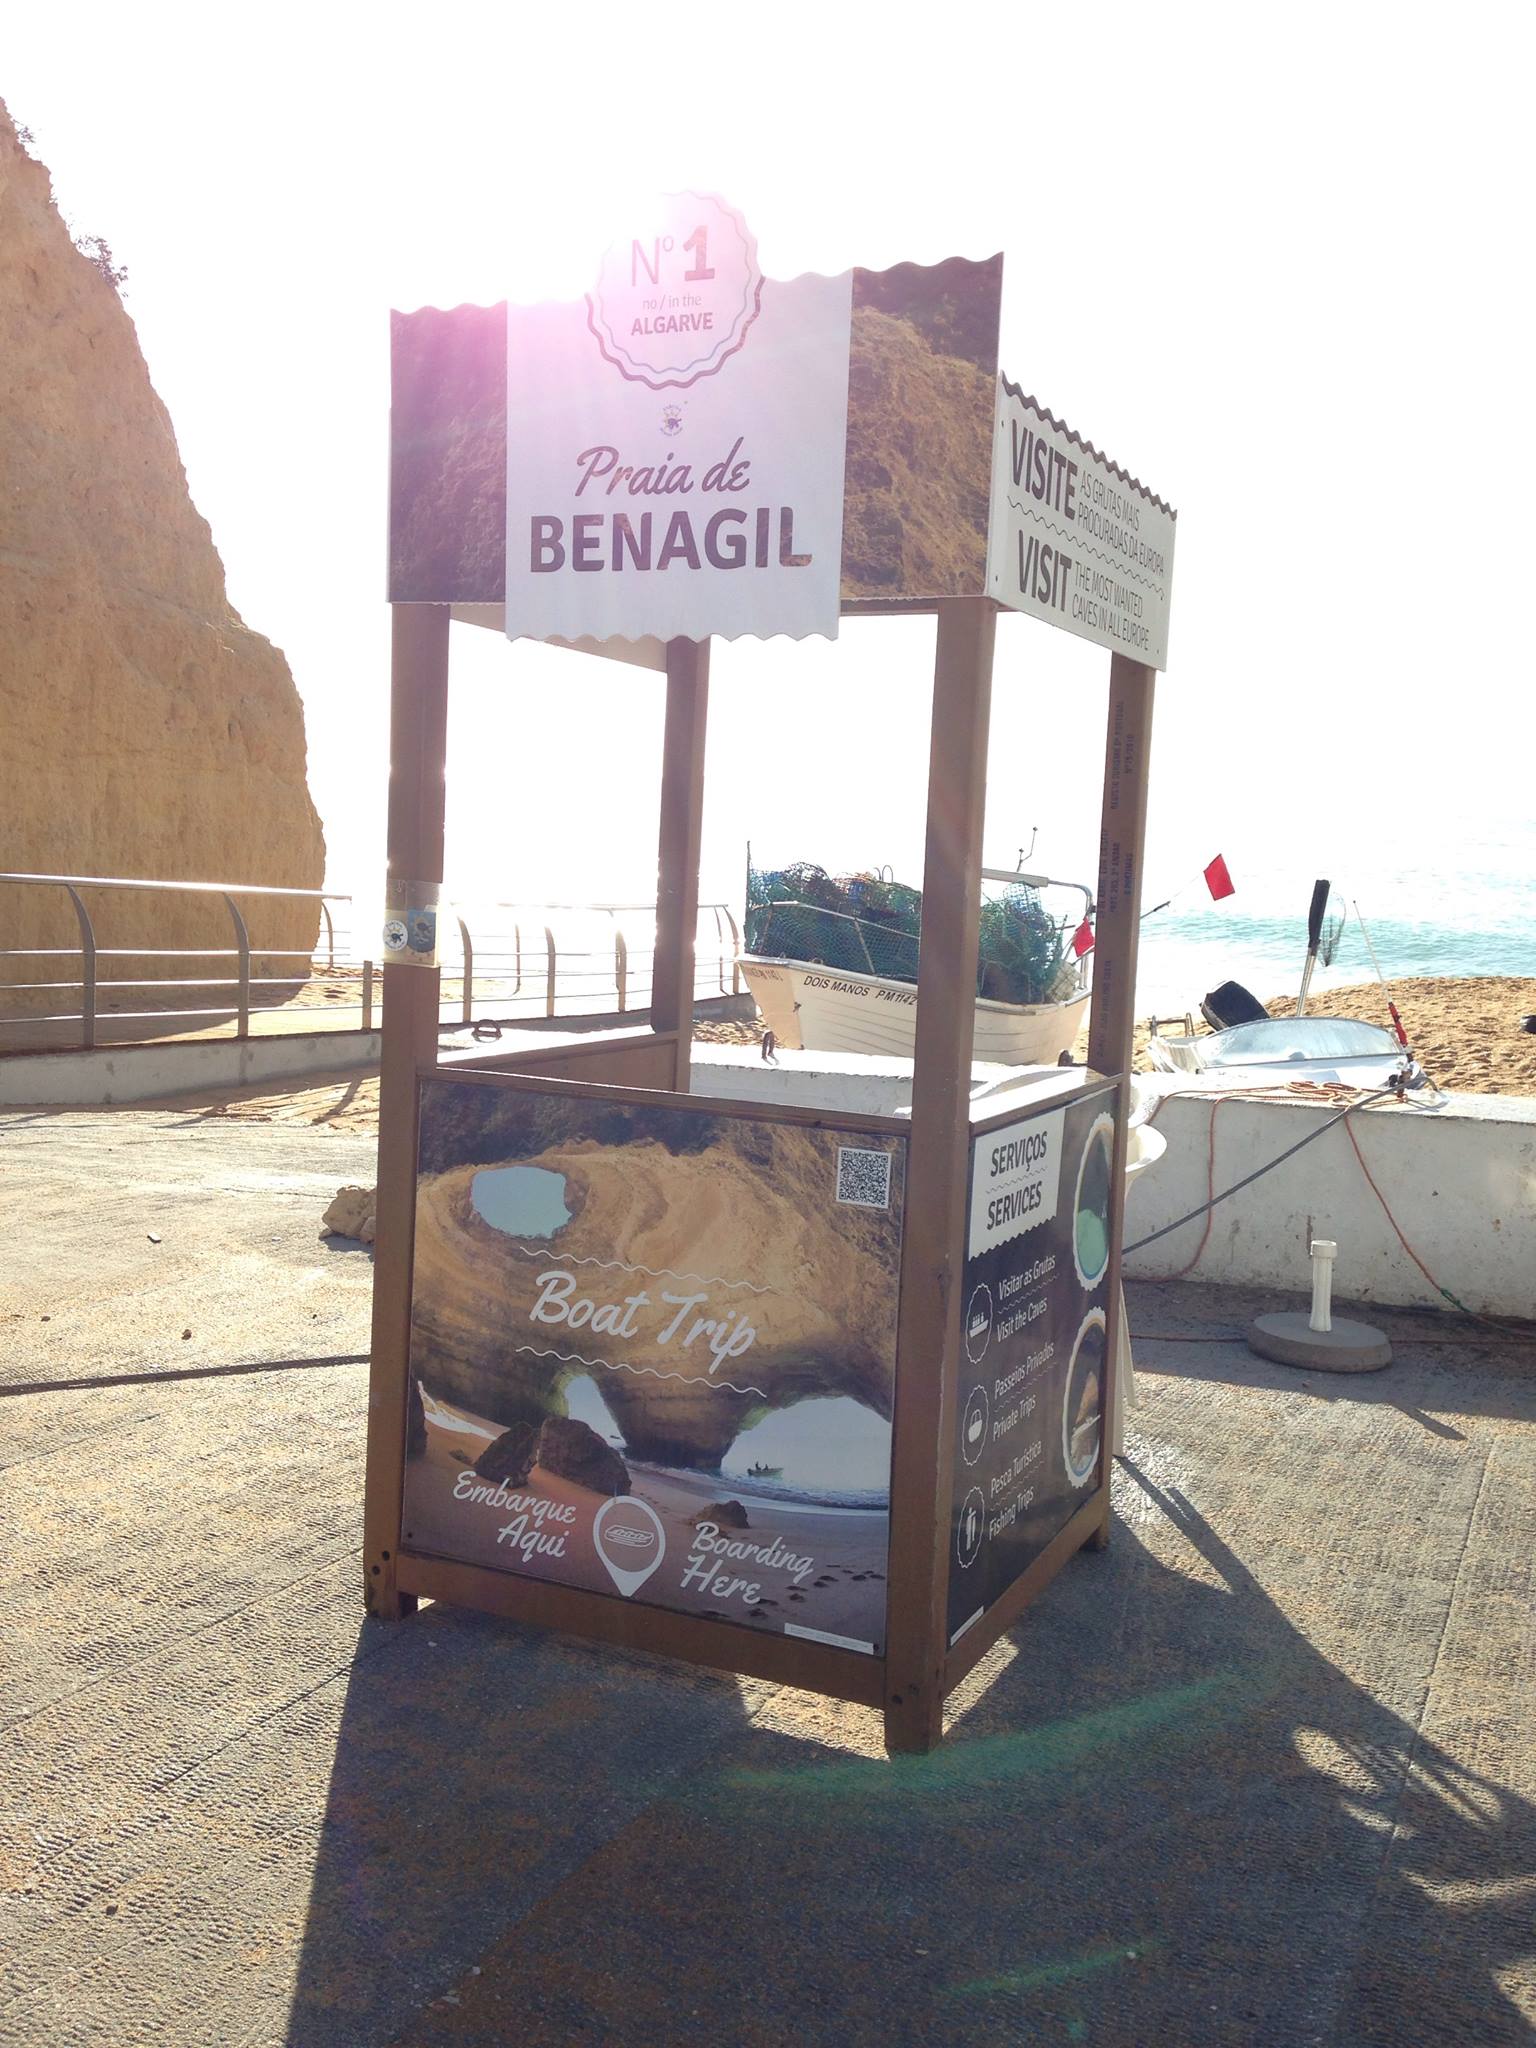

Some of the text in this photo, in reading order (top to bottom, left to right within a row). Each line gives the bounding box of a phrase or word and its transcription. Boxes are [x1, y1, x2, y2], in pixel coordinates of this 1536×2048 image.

[683, 224, 716, 282] 1
[631, 312, 713, 336] ALGARVE
[682, 293, 702, 307] the
[574, 436, 750, 497] Praia de
[1011, 418, 1078, 521] VISITE
[1080, 469, 1141, 532] AS GRUTAS MAIS
[530, 507, 813, 573] BENAGIL
[1077, 501, 1165, 578] PROCURADAS DA EUROPA
[1018, 529, 1073, 613] VISIT
[1075, 560, 1144, 619] THE MOST WANTED
[1072, 593, 1150, 651] CAVES IN ALL EUROPE
[803, 975, 831, 989] DOIS
[831, 981, 871, 997] MANOS
[990, 1130, 1049, 1178] SERVIÇOS
[986, 1180, 1043, 1231] SERVICES
[998, 1254, 1057, 1301] Visitar as Grutas
[529, 1270, 756, 1375] Boat Trip
[996, 1296, 1048, 1343] Visit the Caves
[994, 1341, 1056, 1400] Passeios Privados
[992, 1394, 1037, 1442] Private Trips
[990, 1439, 1043, 1499] Pesca Turística
[452, 1470, 577, 1528] Embarque
[988, 1485, 1035, 1541] Fishing Trips
[497, 1514, 570, 1562] Aqui
[691, 1522, 814, 1581] Boarding
[679, 1554, 762, 1605] Here
